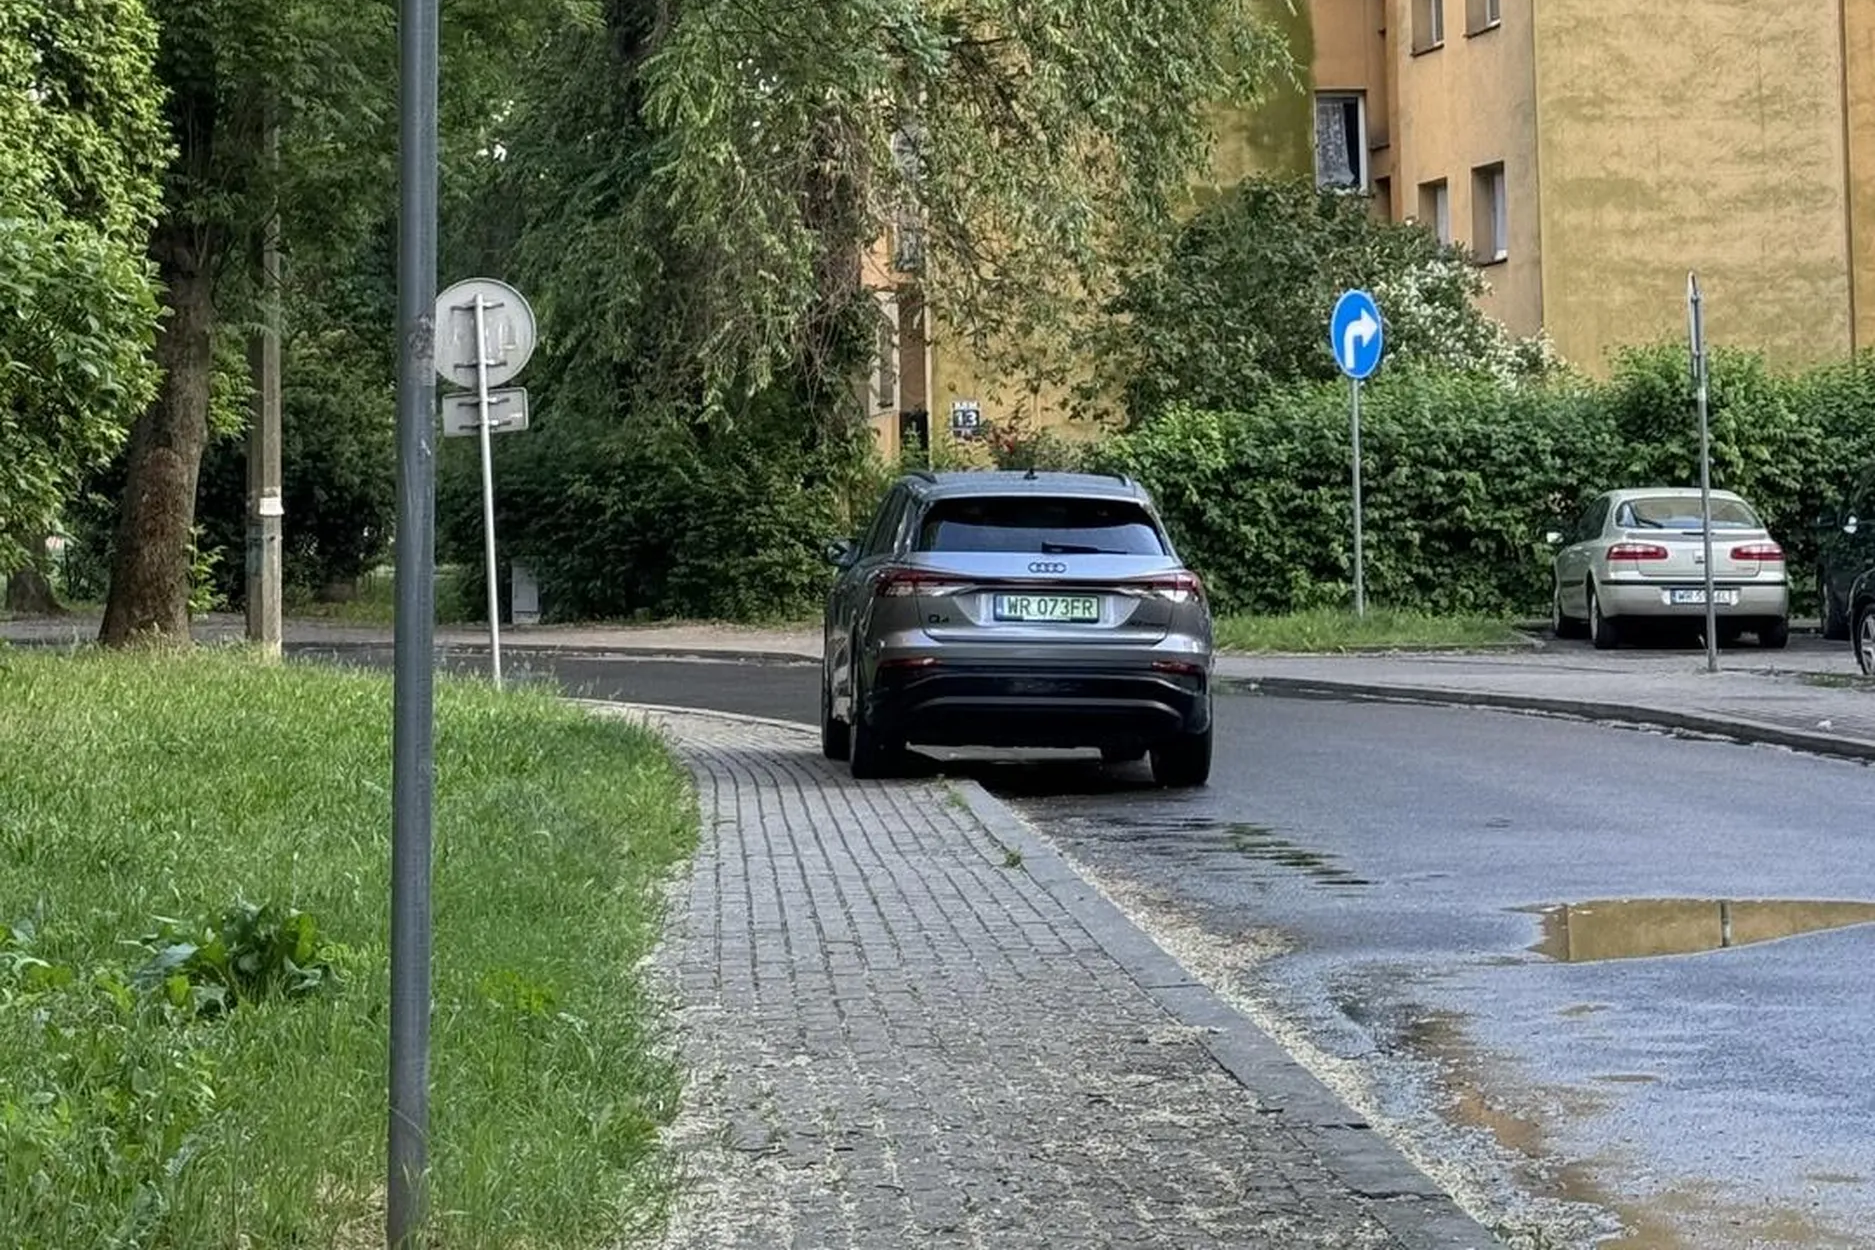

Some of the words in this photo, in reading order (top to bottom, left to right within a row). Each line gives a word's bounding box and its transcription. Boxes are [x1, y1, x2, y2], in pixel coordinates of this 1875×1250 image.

[955, 410, 977, 426] 13
[1007, 597, 1031, 615] WR
[1037, 598, 1093, 616] 073FR
